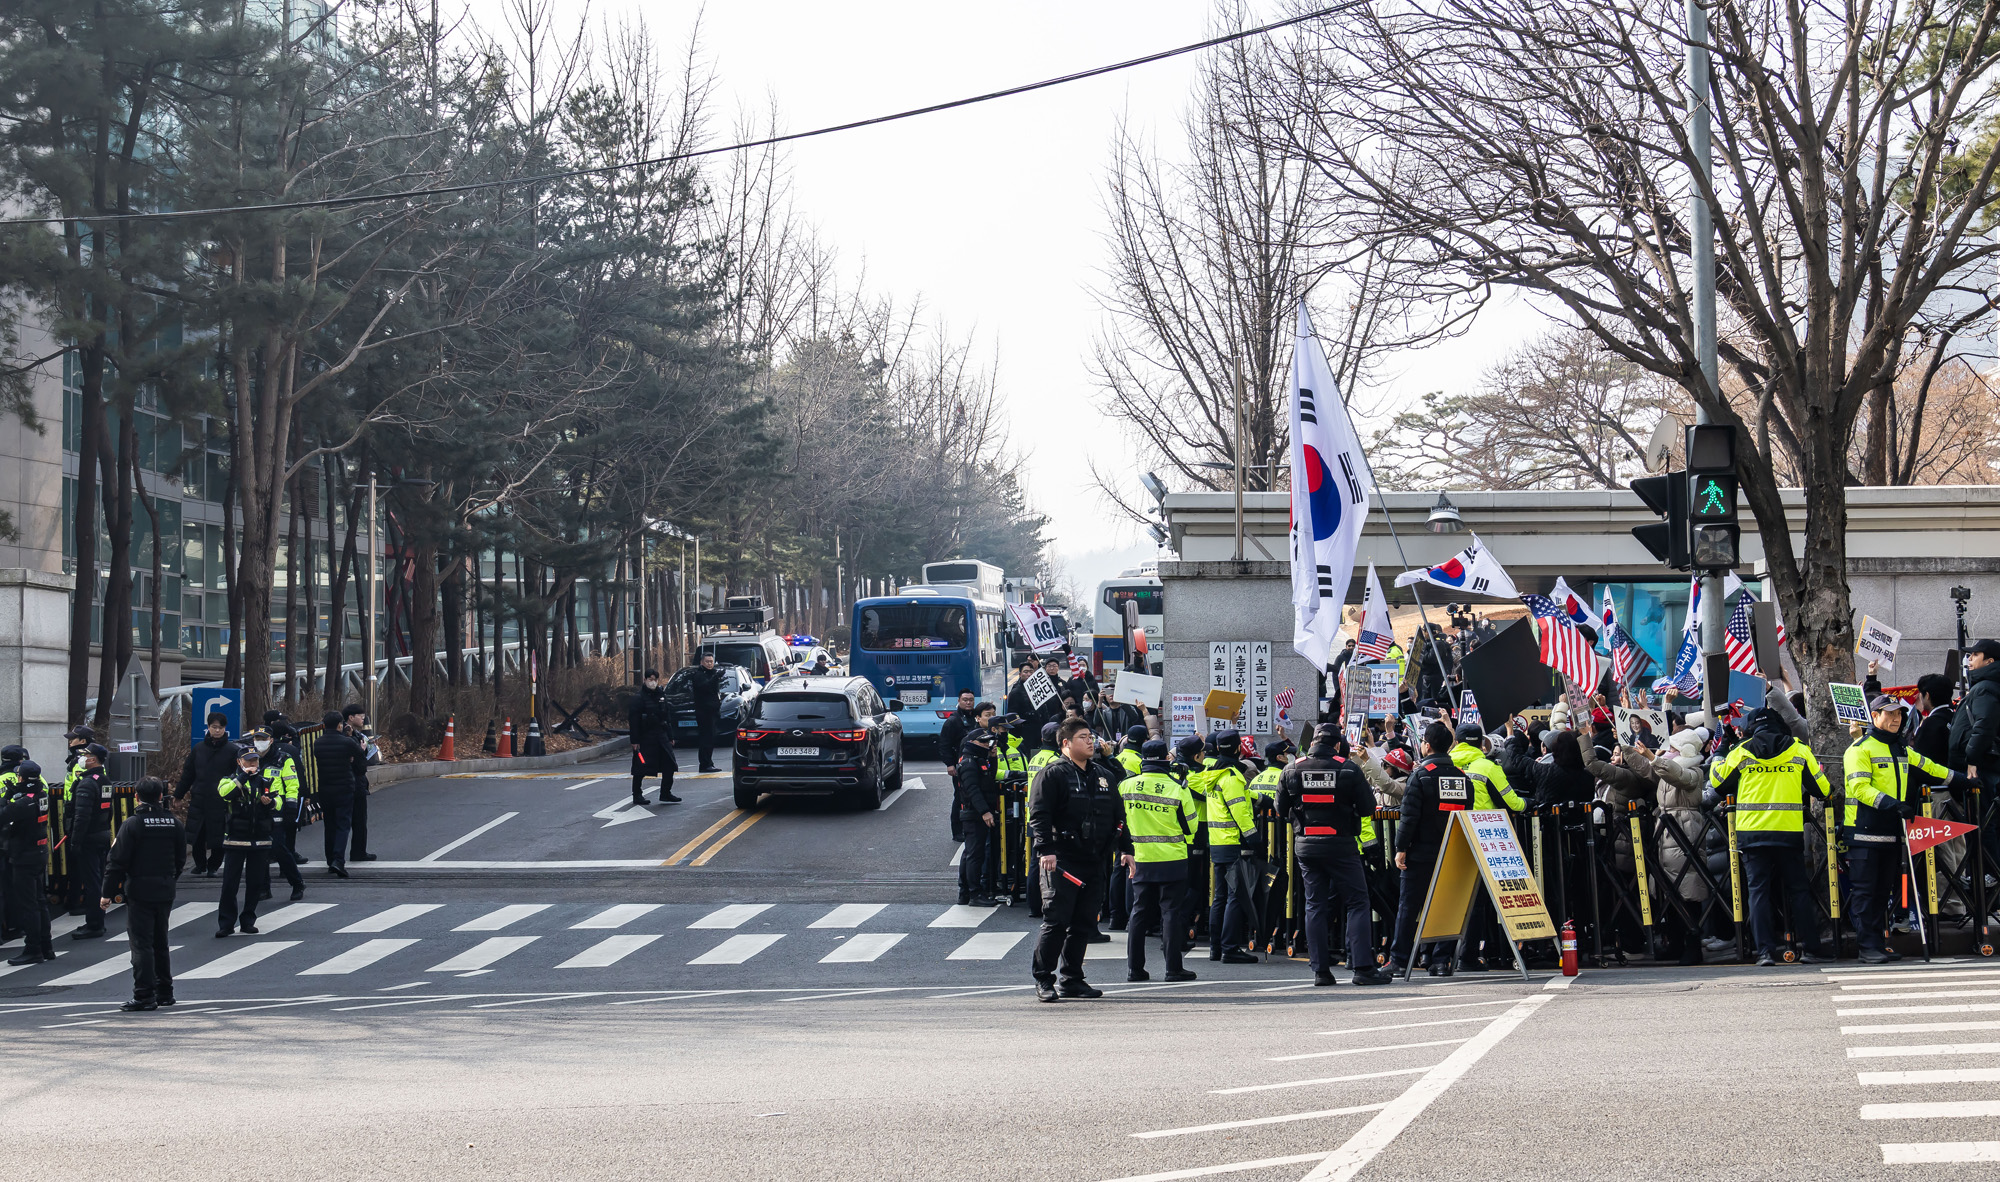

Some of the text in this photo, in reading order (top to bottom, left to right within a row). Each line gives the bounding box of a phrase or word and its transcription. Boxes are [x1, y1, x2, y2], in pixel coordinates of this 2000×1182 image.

[1869, 626, 1893, 646] 내란재판
[1027, 671, 1048, 692] 내란은
[1214, 645, 1226, 732] 서울회원
[1256, 644, 1268, 733] 서울고등법원
[1032, 682, 1055, 706] 없었다
[1837, 705, 1867, 720] 힘내세요
[1748, 765, 1795, 774] POLICE
[1306, 773, 1332, 781] 경찰
[1442, 779, 1463, 789] 경찰
[1136, 780, 1166, 794] 경찰
[1129, 802, 1169, 813] POLICE
[1471, 813, 1504, 823] 중요재판으로
[1478, 828, 1509, 839] 외부 차량
[1909, 825, 1952, 841] 48기-2
[1730, 832, 1738, 875] POLICE
[1487, 856, 1524, 868] 외부주차장
[1498, 878, 1528, 892] 오토바이
[1499, 893, 1541, 909] 인도 진입금지
